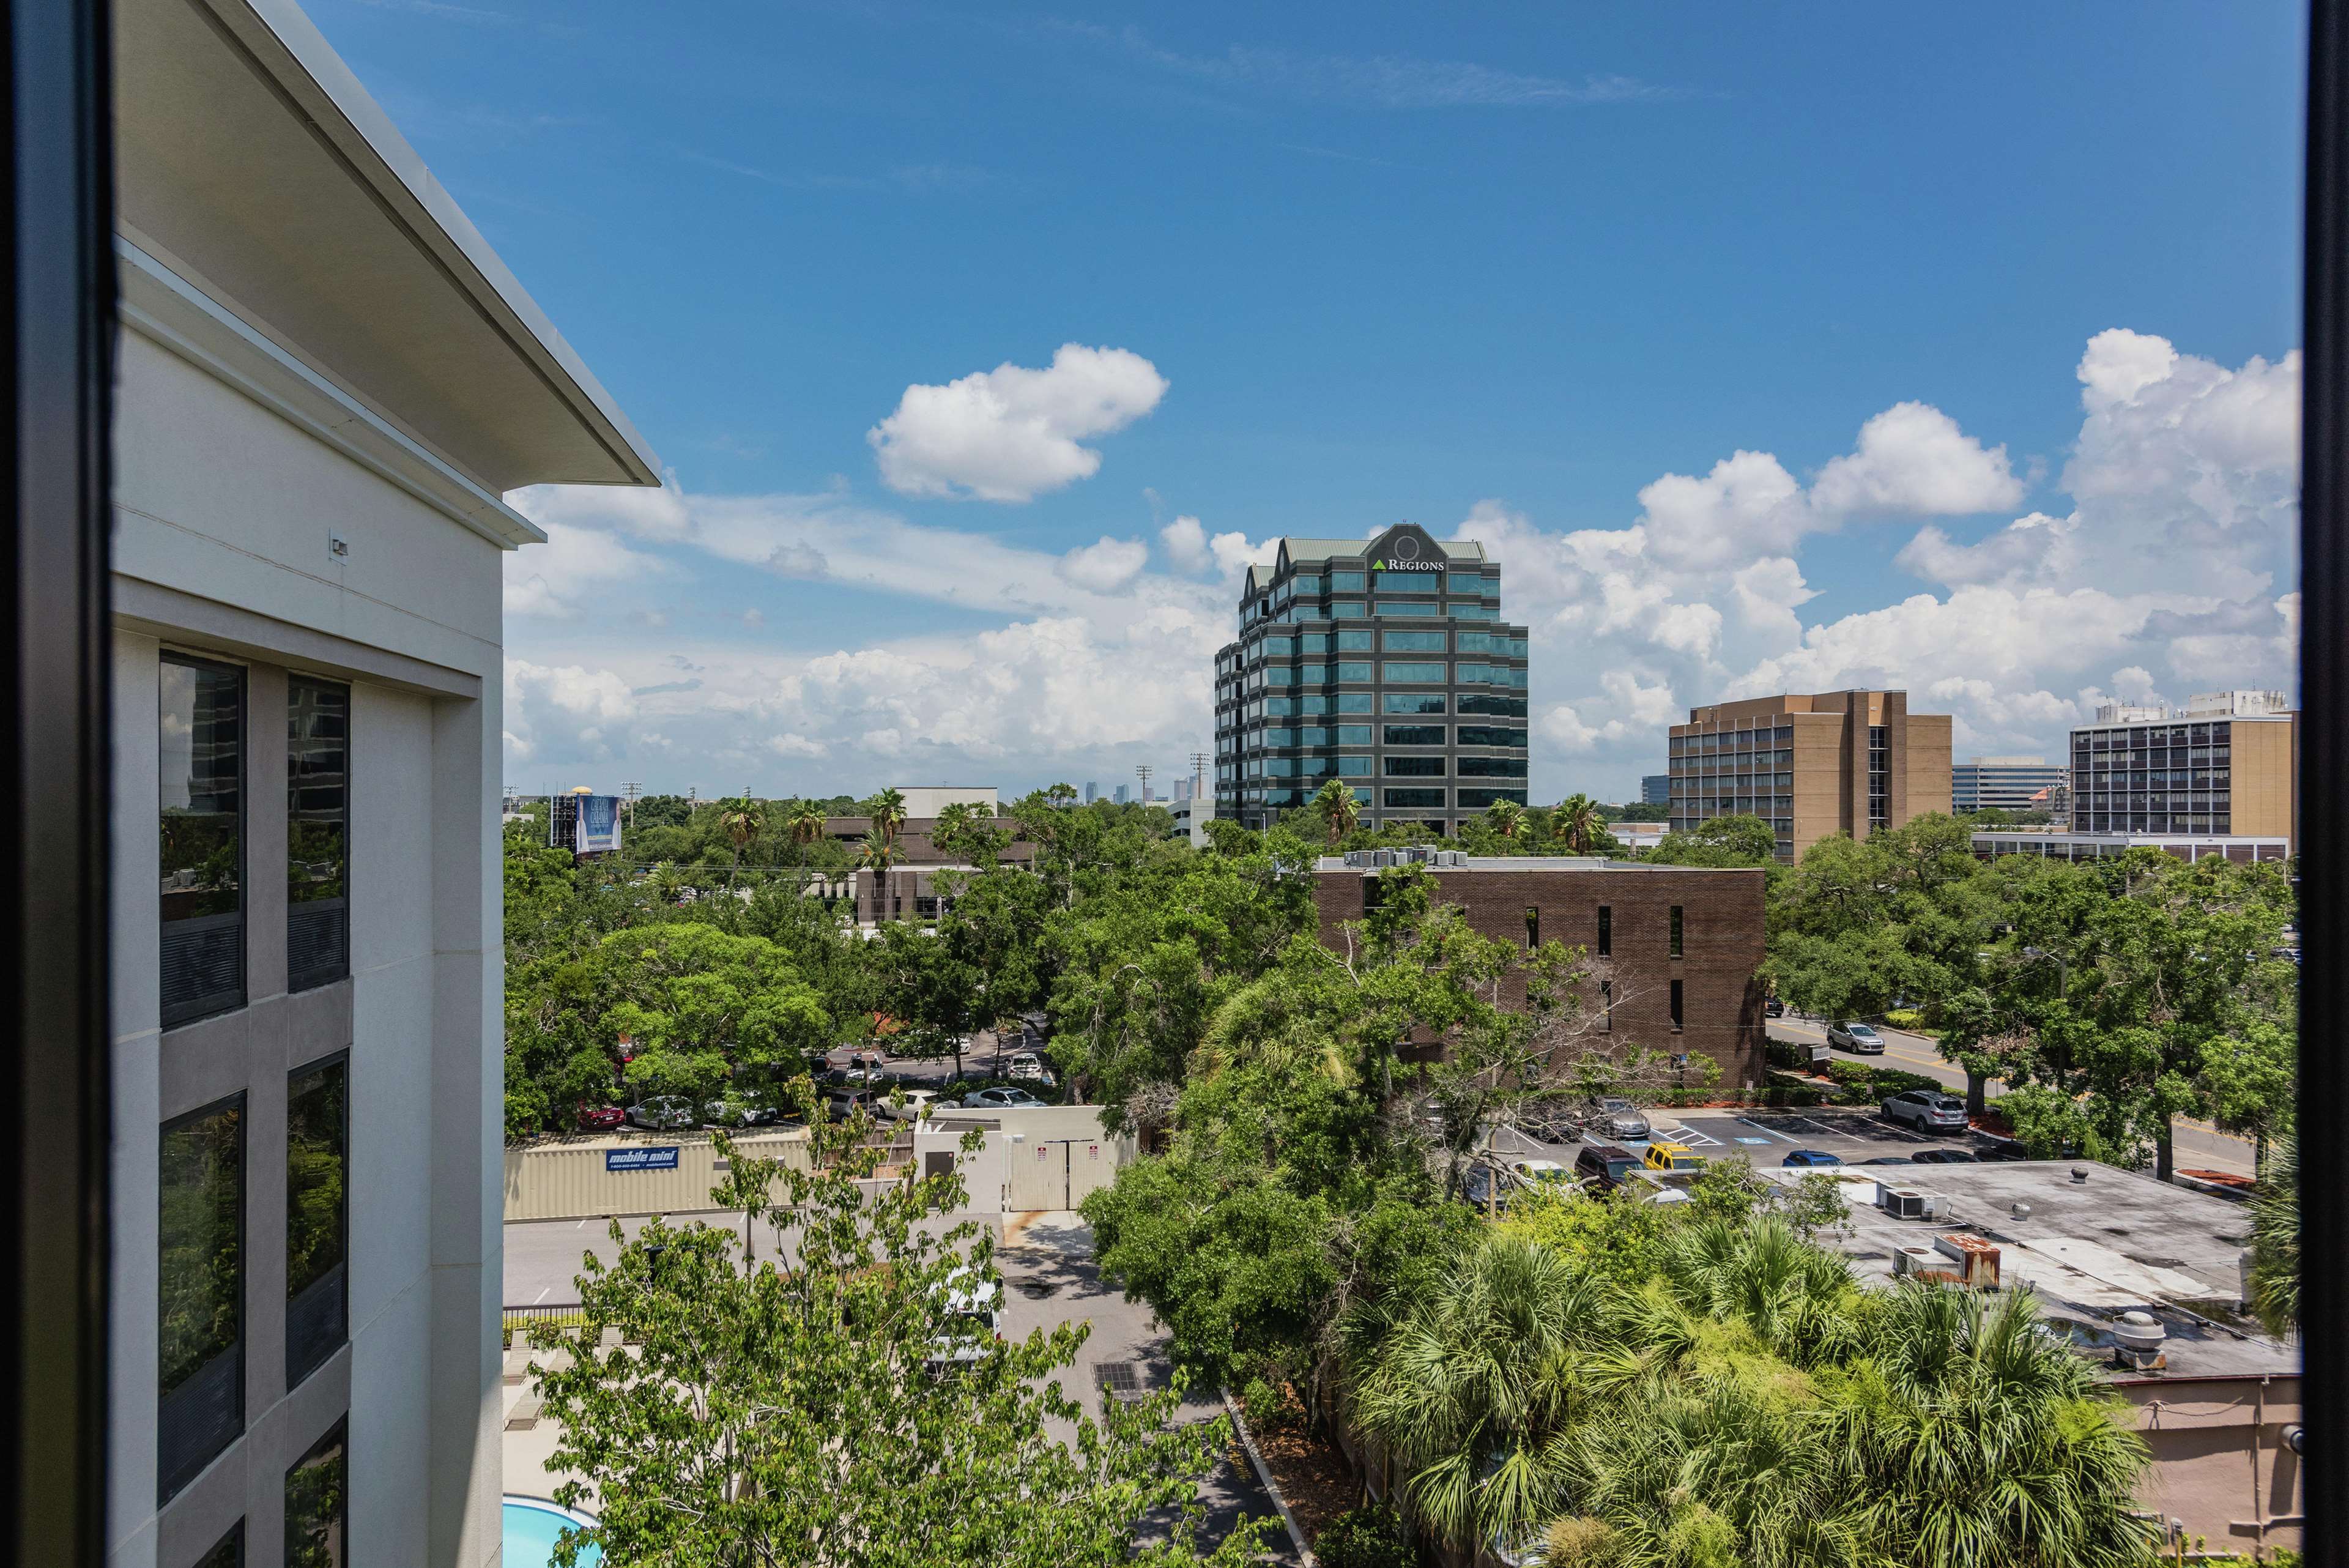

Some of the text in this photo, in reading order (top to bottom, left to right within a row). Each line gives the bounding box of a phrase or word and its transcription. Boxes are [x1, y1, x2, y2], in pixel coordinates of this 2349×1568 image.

[1388, 559, 1444, 571] REGIONS
[590, 811, 609, 823] CATANIA
[609, 1150, 676, 1163] mobile mini
